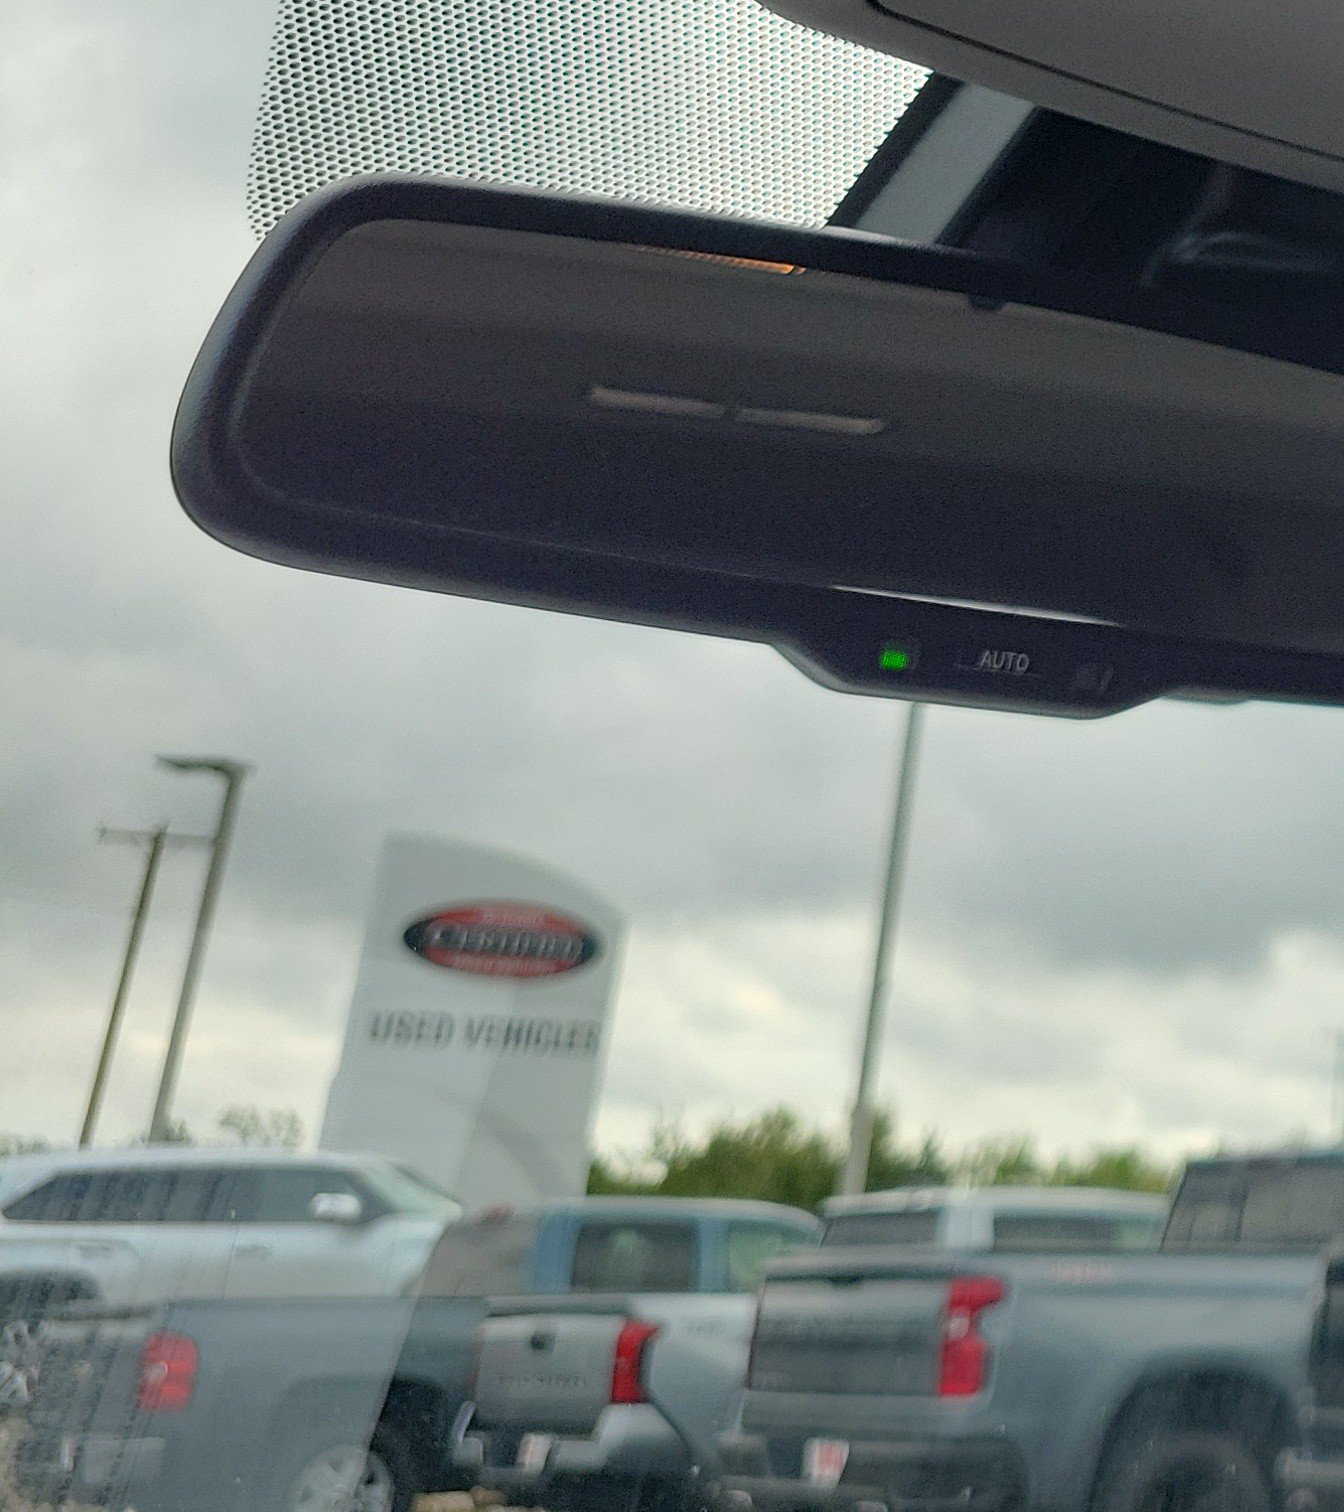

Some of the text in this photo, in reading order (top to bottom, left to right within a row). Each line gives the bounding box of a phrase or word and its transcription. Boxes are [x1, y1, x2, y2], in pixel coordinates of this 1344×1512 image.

[979, 649, 1030, 674] AUTO
[369, 1010, 599, 1055] USED VEHICLES
